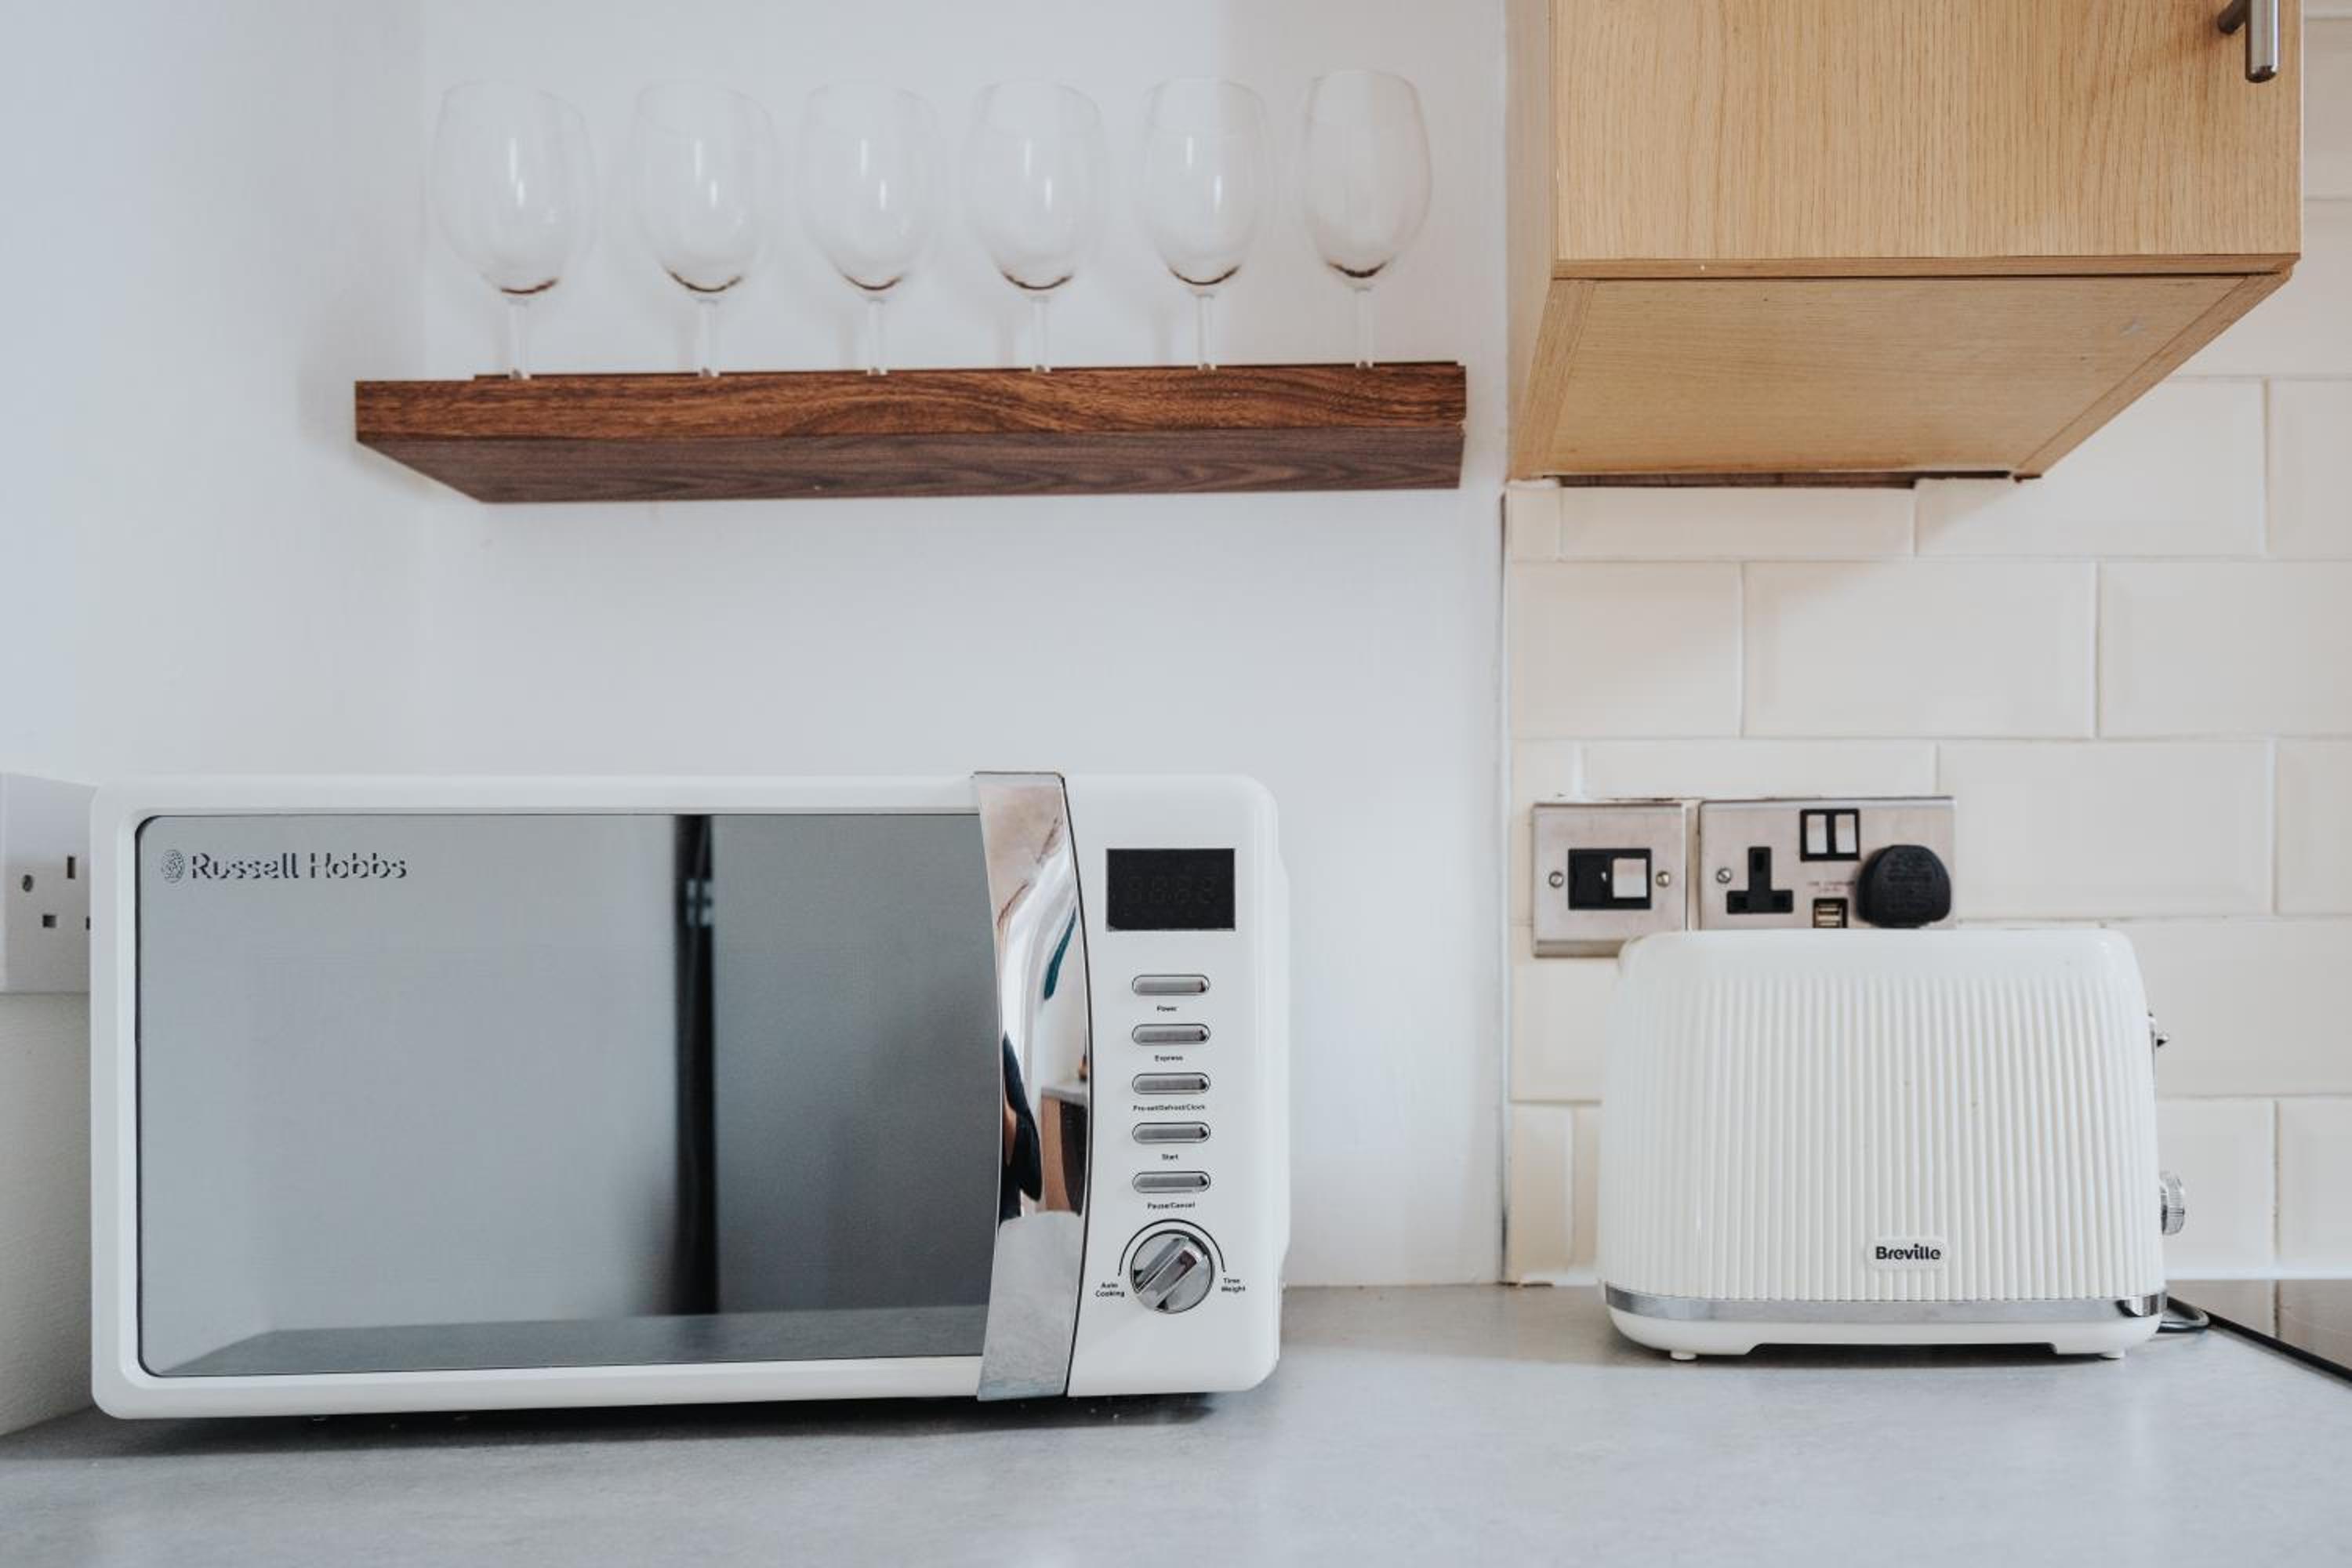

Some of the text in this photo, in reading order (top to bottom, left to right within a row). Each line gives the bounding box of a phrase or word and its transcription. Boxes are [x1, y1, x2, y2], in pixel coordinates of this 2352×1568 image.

[192, 852, 408, 879] Russell Hobbs
[1875, 1243, 1942, 1260] Breville
[1221, 1284, 1246, 1293] Weight
